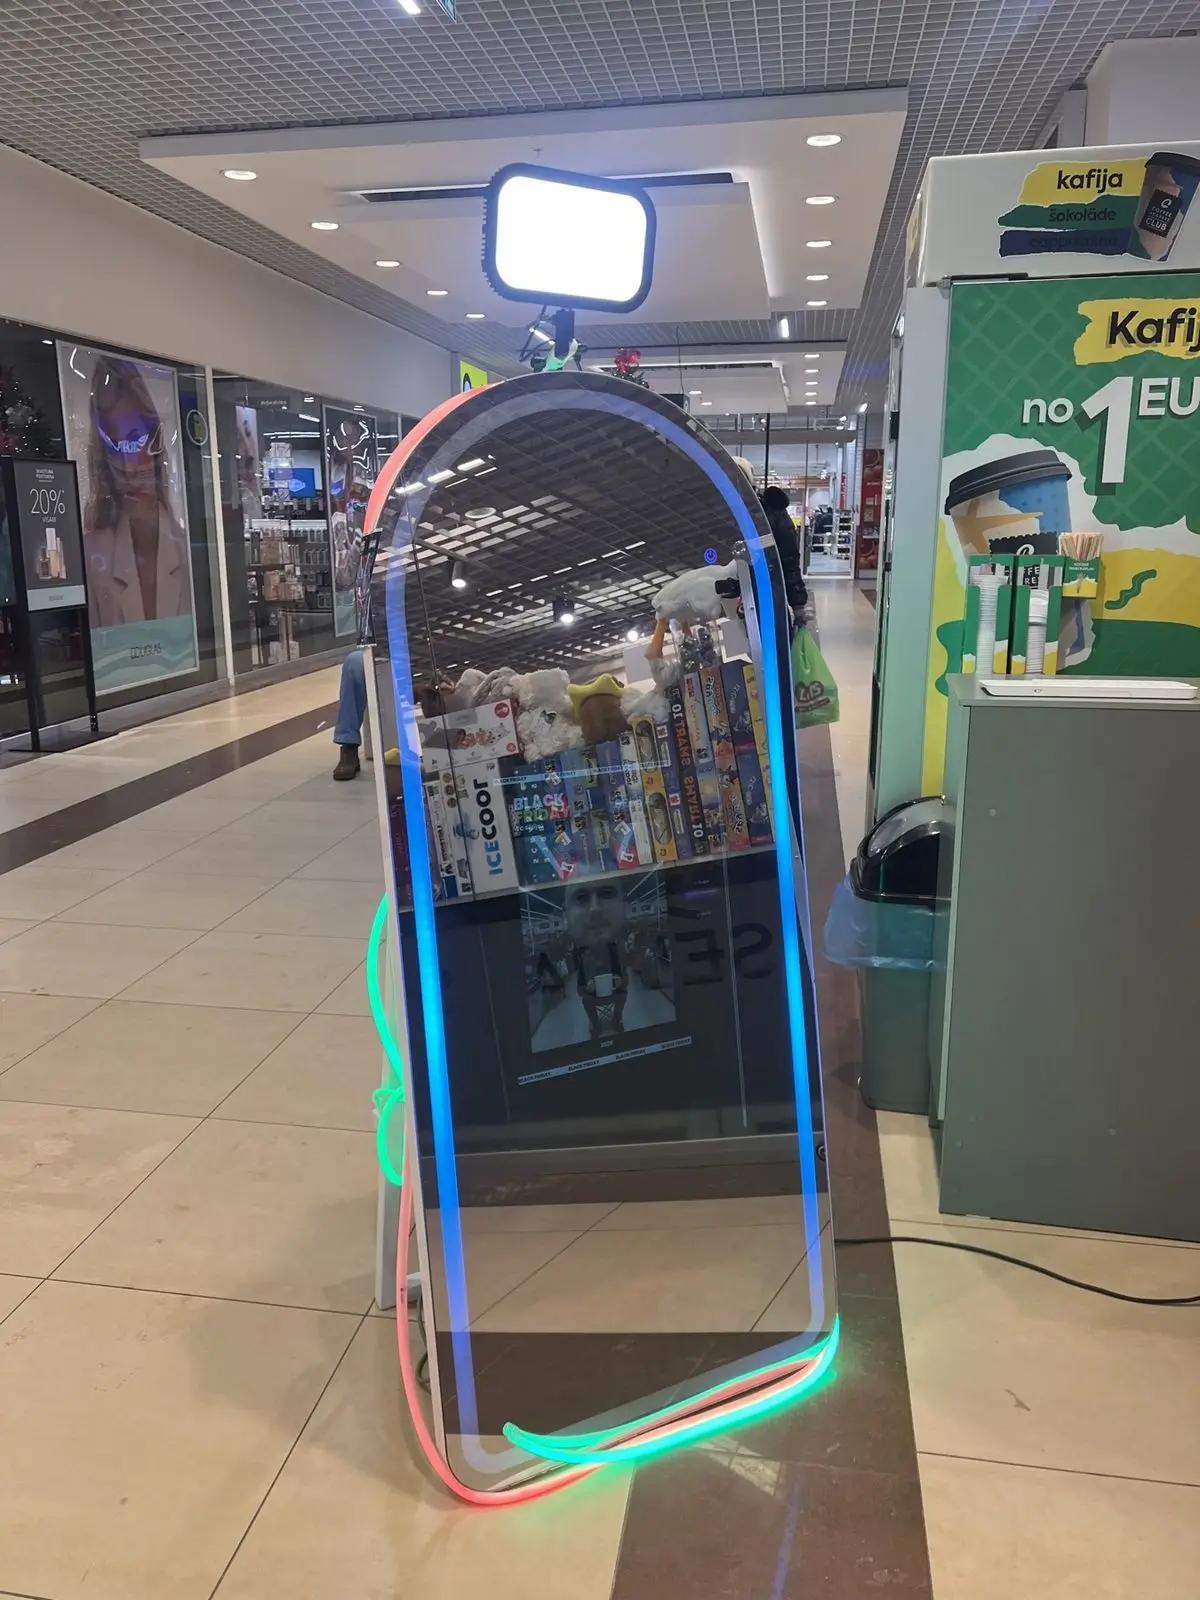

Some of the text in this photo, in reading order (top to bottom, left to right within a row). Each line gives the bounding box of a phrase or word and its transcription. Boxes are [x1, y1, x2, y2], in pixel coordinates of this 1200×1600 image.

[1057, 168, 1123, 193] kafija
[1048, 208, 1117, 223] šokolāde
[1145, 217, 1168, 231] CLUB
[1022, 397, 1074, 424] no
[1080, 376, 1134, 484] 1
[514, 792, 564, 810] BLACK
[514, 807, 569, 822] FRIDAY
